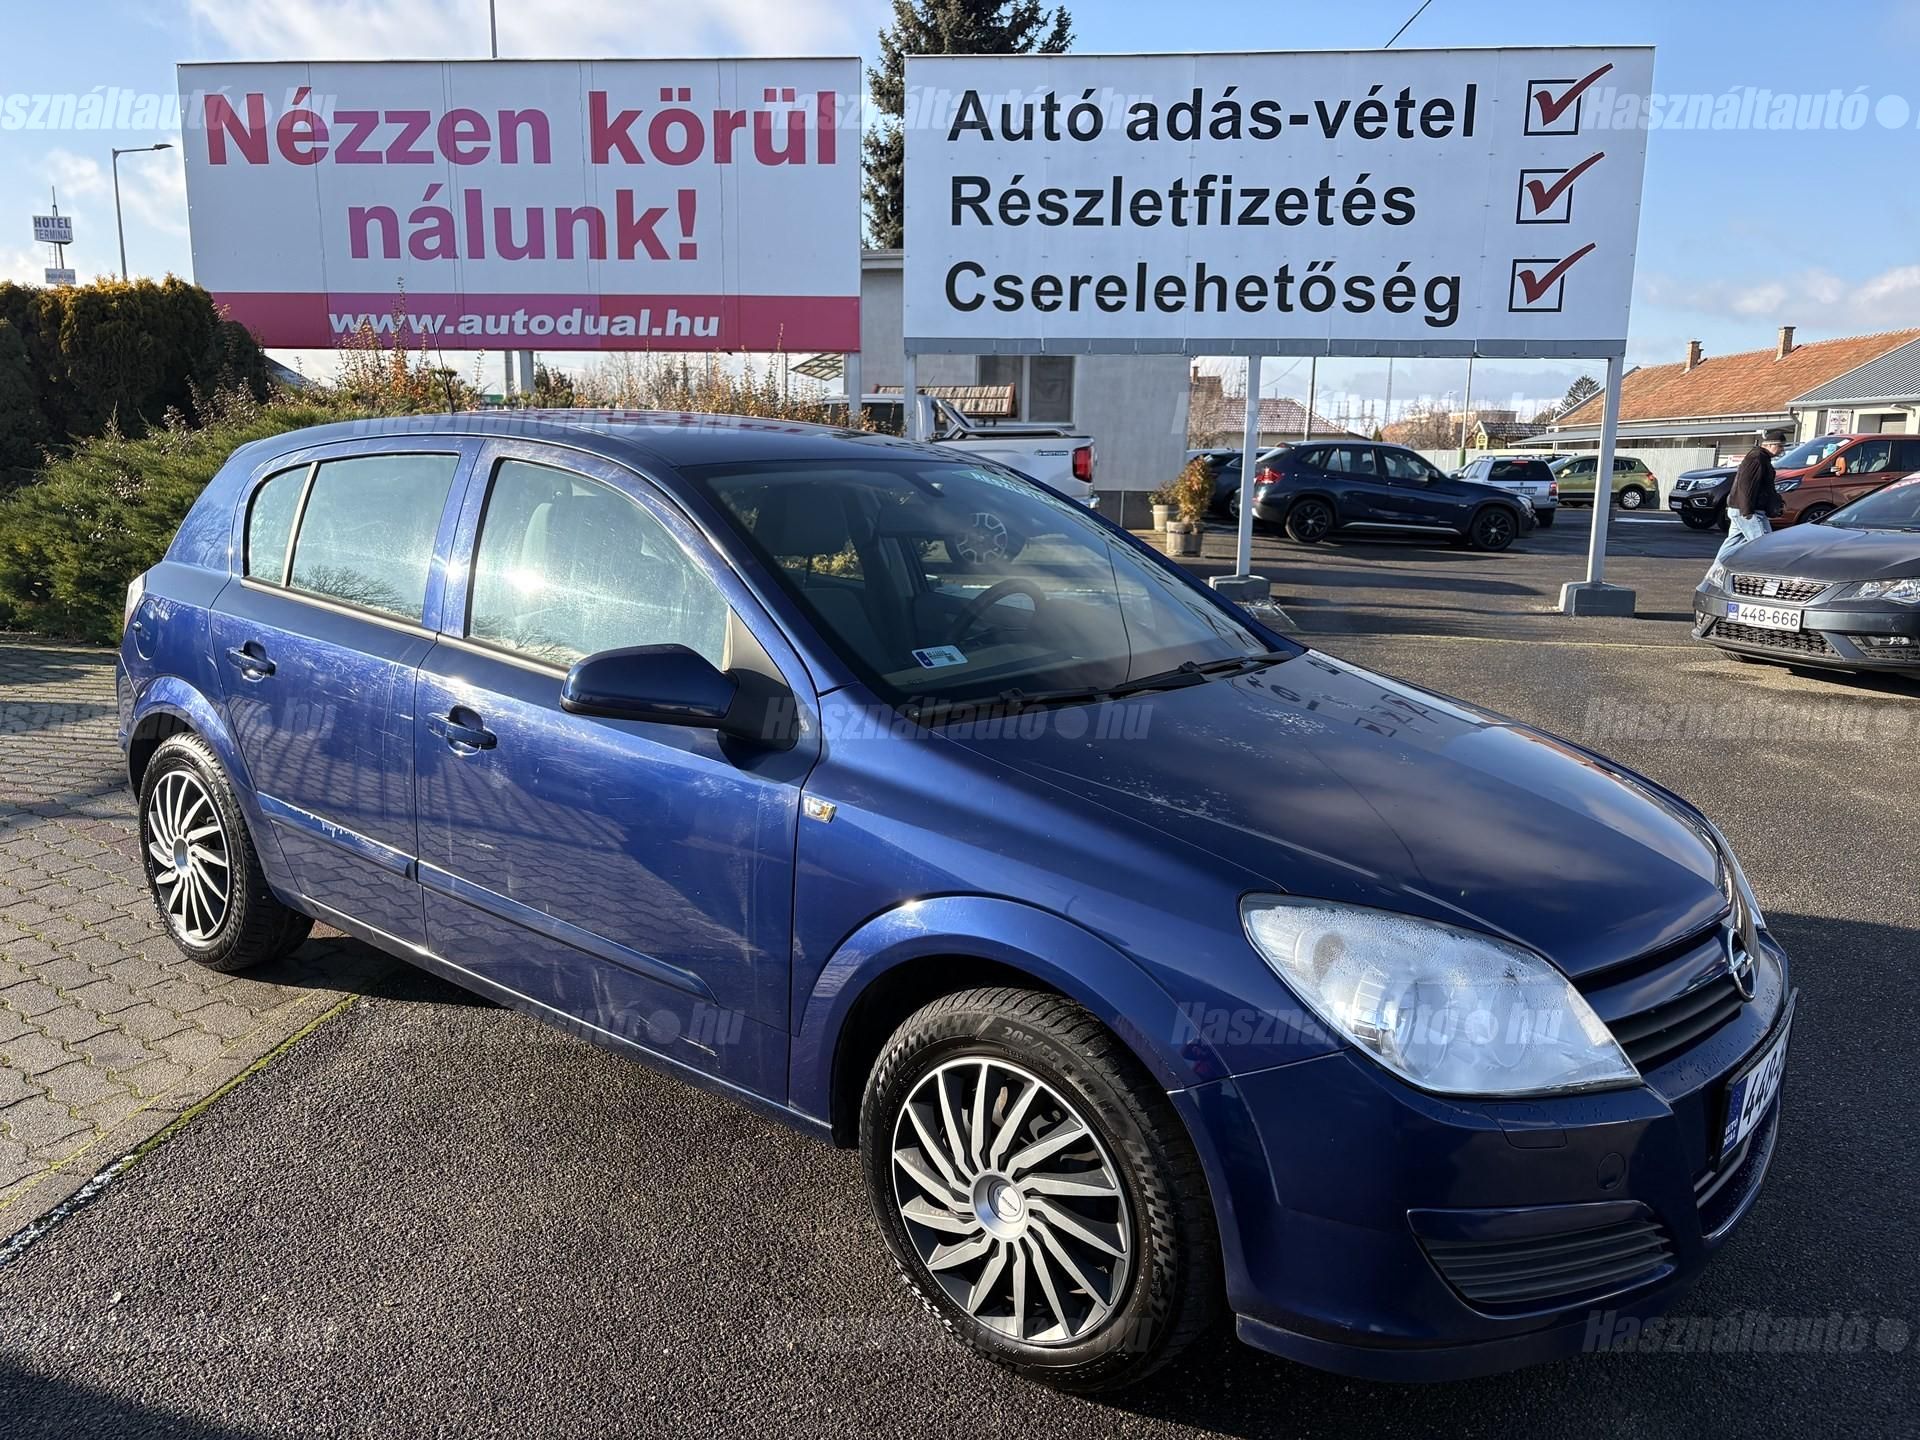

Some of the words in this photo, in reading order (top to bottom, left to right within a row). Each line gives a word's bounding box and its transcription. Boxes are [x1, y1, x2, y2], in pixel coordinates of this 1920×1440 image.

[204, 87, 552, 166] Nézzen
[588, 87, 838, 166] körül
[946, 88, 1104, 142] Autó
[1126, 83, 1478, 141] adás-vétel
[34, 217, 71, 228] HOTEL
[348, 183, 698, 262] nálunk!
[951, 173, 1417, 227] Részletfizetés
[35, 229, 73, 240] TERMINAL
[945, 260, 1462, 328] Cserelehetőség
[328, 308, 720, 337] www.autodual.hu
[1741, 607, 1799, 627] 448-666
